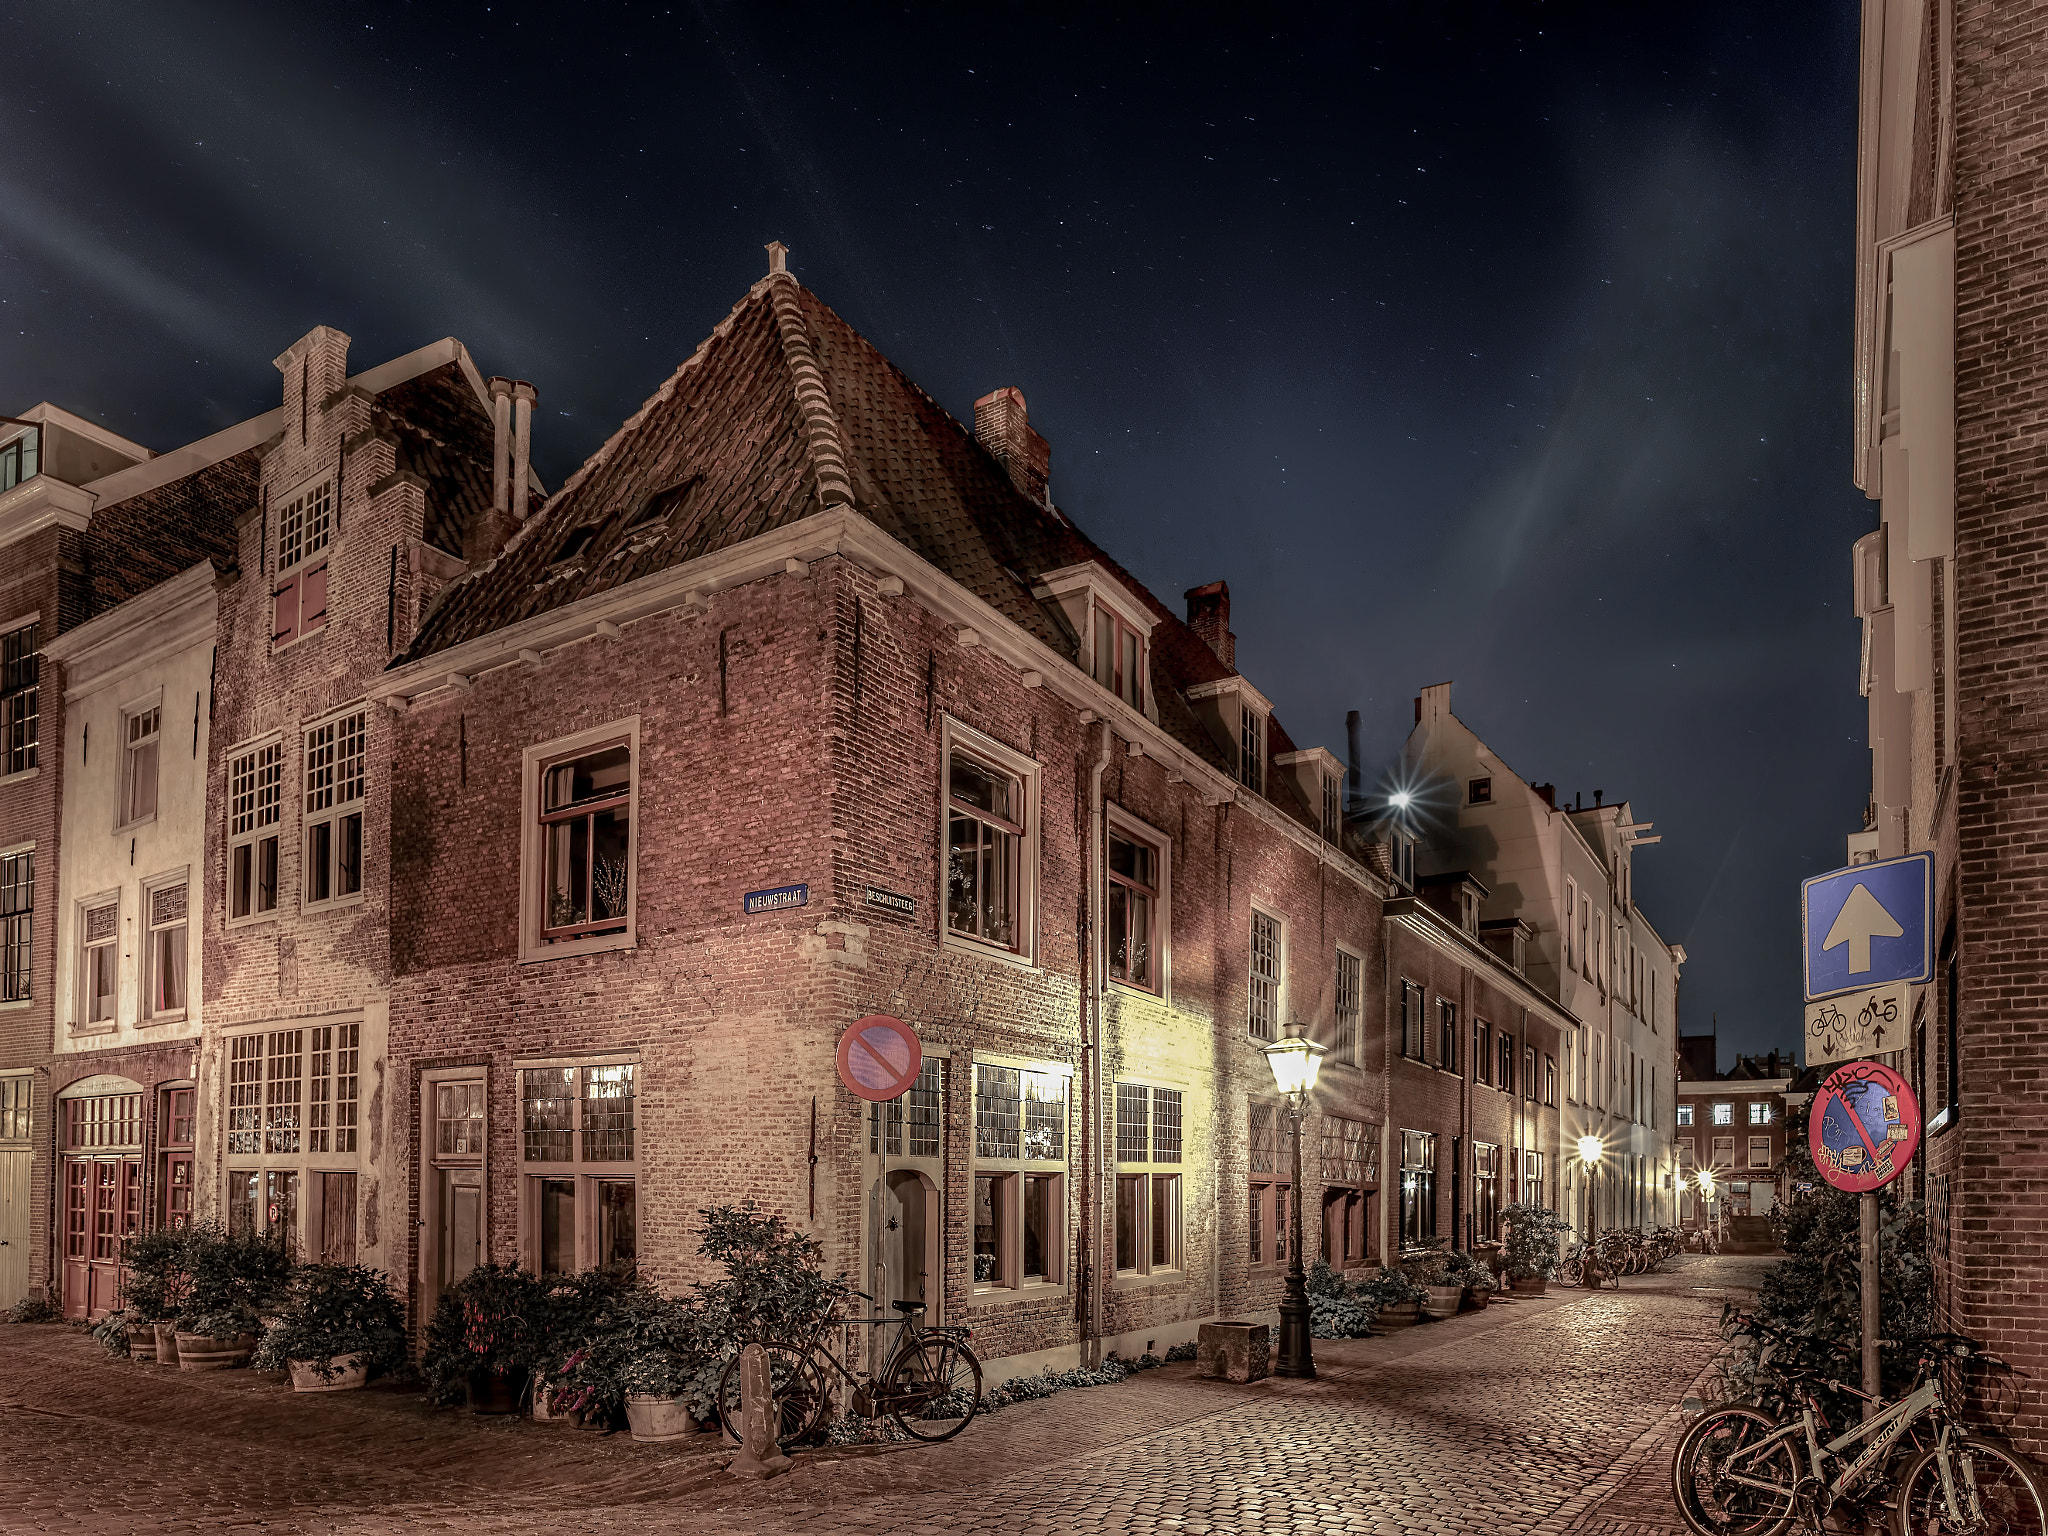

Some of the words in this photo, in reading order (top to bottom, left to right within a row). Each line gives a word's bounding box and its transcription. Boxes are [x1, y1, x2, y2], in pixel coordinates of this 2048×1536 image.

[749, 889, 802, 908] NIEUWSTRAAT
[868, 890, 913, 911] BESCHUITSTEEG
[1854, 1419, 1899, 1468] FERRINI
